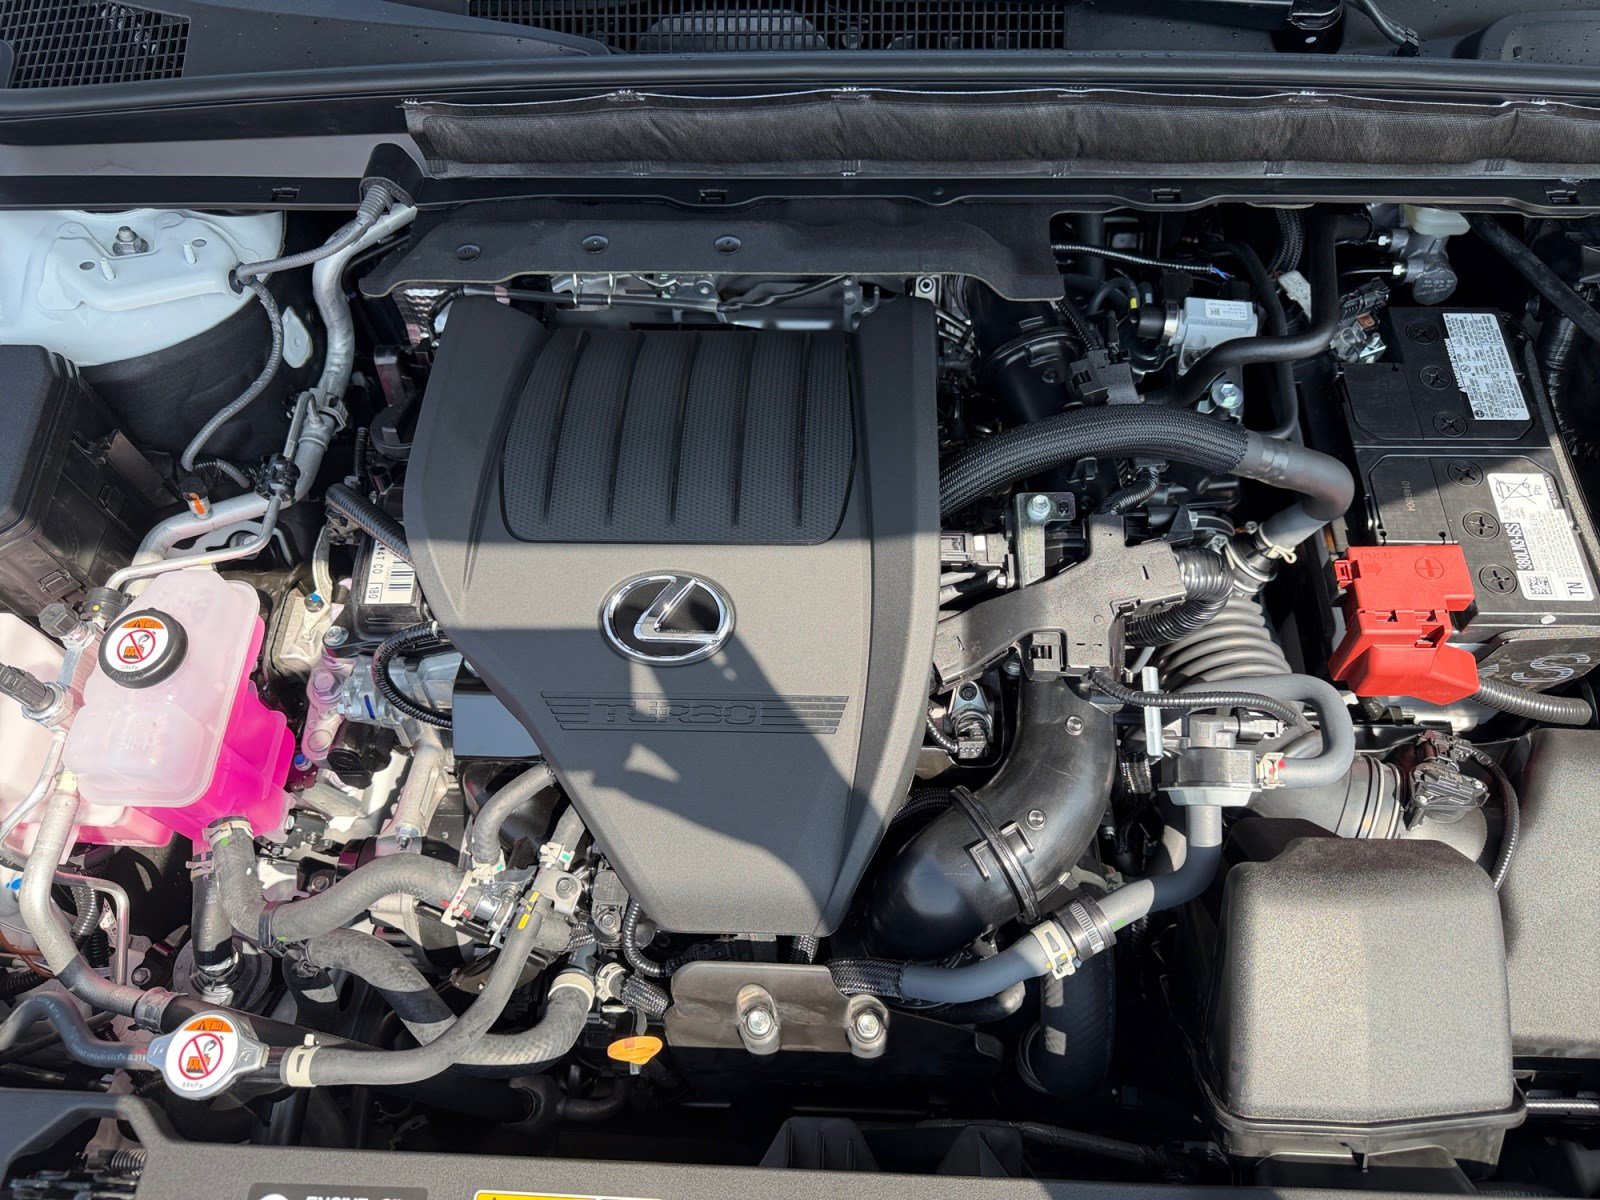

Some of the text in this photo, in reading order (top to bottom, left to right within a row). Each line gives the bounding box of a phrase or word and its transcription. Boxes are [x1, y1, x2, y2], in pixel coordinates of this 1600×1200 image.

[1504, 523, 1533, 570] 380LN3-ISS
[1566, 581, 1585, 596] TN
[594, 700, 757, 725] TURBO
